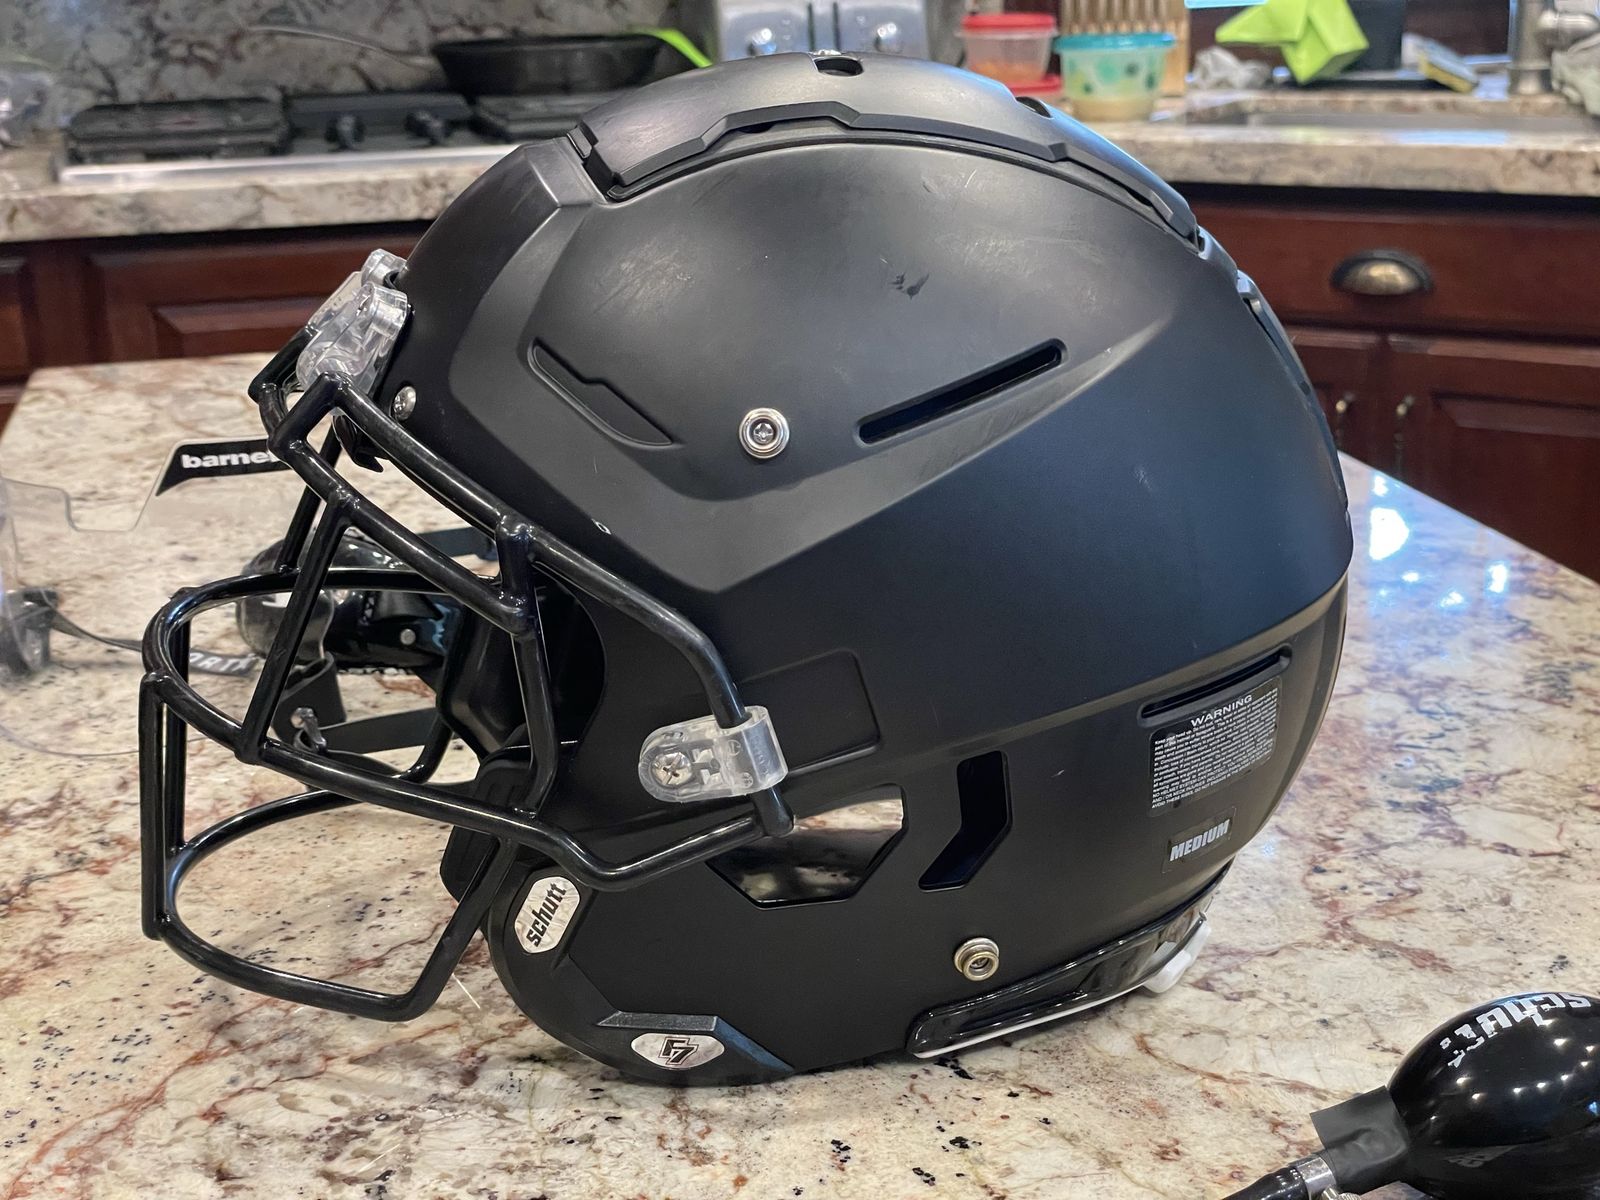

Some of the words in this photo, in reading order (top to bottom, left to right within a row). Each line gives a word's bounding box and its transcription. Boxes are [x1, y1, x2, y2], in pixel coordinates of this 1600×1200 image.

[1191, 695, 1252, 726] WARNING
[1170, 819, 1230, 861] MEDIUM
[526, 883, 566, 947] schutt
[658, 1036, 699, 1065] F7
